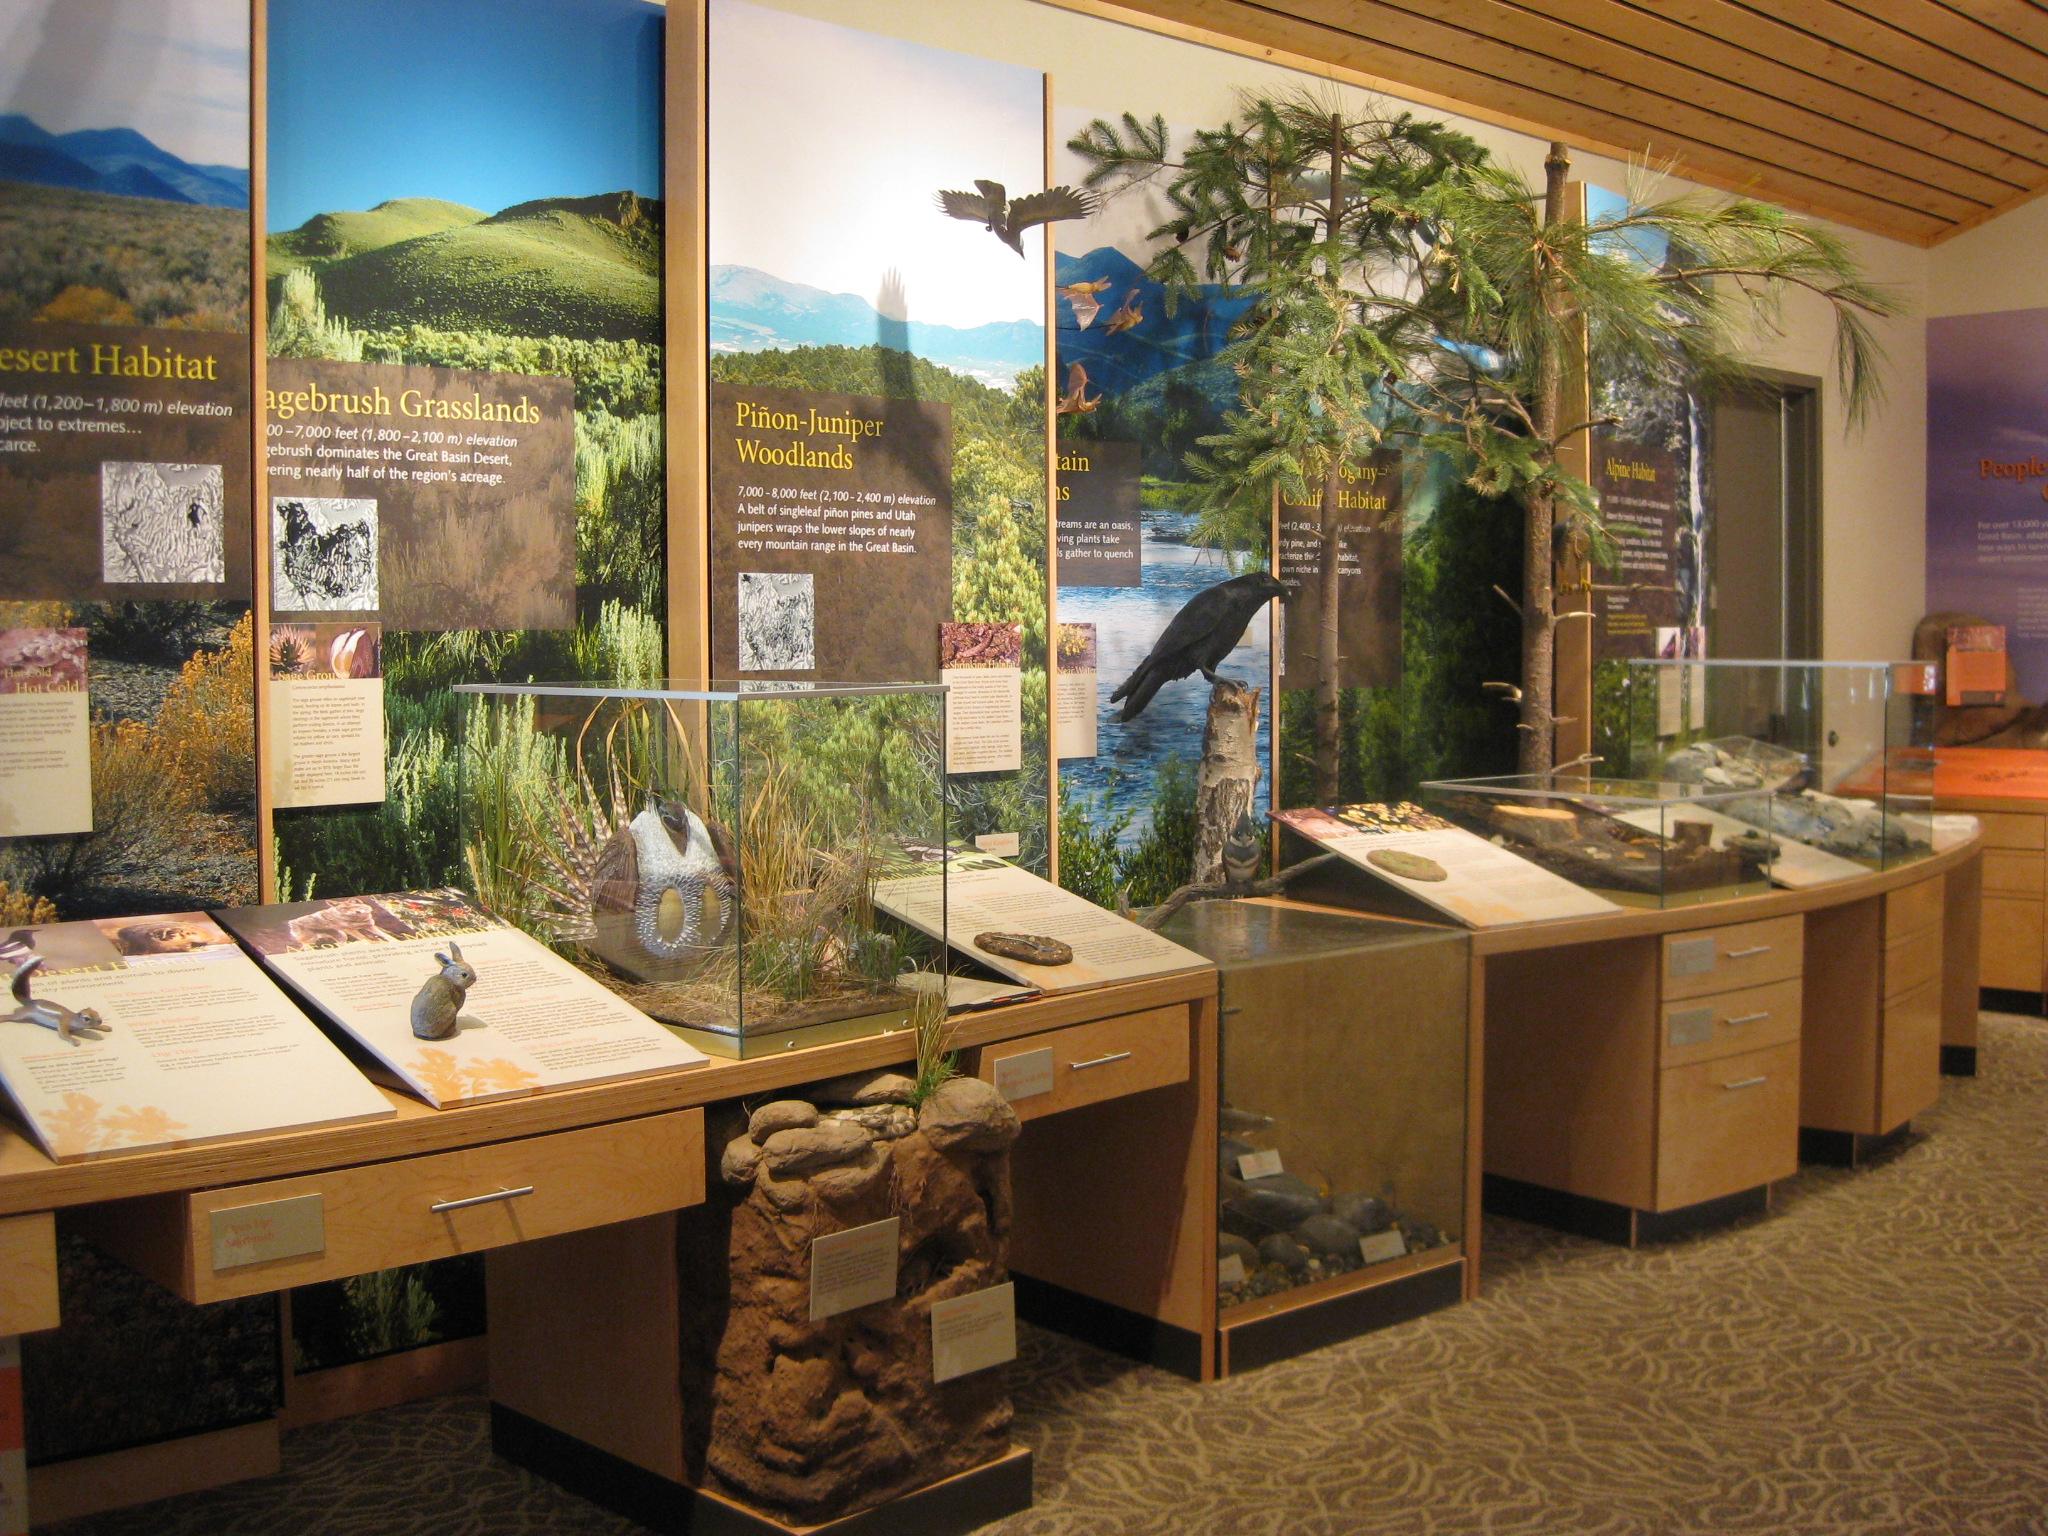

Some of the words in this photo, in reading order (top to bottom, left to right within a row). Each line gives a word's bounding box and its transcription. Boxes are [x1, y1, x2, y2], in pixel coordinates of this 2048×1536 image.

[0, 347, 80, 374] esert
[91, 343, 219, 381] Habitat
[143, 401, 163, 416] m)
[167, 400, 233, 417] elevation
[267, 383, 391, 419] agebrush
[400, 390, 541, 424] Grasslands
[37, 416, 54, 431] to
[58, 418, 142, 435] extremes...
[736, 401, 884, 443] Piñon-Juniper
[334, 426, 360, 441] feet
[447, 432, 463, 447] m)
[466, 433, 518, 448] elevation
[317, 445, 380, 460] dominates
[384, 448, 403, 461] the
[406, 448, 438, 462] Great
[441, 451, 471, 464] Basin
[474, 452, 512, 467] Desert,
[736, 438, 854, 470] Woodlands
[1056, 450, 1090, 472] tain
[305, 465, 343, 482] nearly
[347, 466, 370, 479] half
[373, 467, 387, 479] of
[390, 468, 408, 481] the
[412, 470, 457, 484] region's
[460, 473, 506, 487] acreage.
[800, 488, 817, 501] feet
[883, 493, 896, 506] m)
[898, 494, 936, 506] elevation
[1338, 490, 1388, 511] Habitat
[738, 503, 746, 514] A
[748, 502, 766, 515] belt
[768, 503, 778, 515] of
[780, 505, 822, 519] singleleaf
[824, 507, 849, 521] piñon
[851, 508, 874, 521] pines
[876, 509, 893, 521] and
[895, 510, 917, 522] Utah
[737, 520, 774, 535] junipers
[776, 524, 802, 536] wraps
[805, 522, 820, 534] the
[822, 523, 847, 535] lower
[849, 524, 876, 539] slopes
[878, 525, 888, 536] of
[890, 526, 916, 540] nearly
[1084, 521, 1097, 530] are
[1099, 521, 1110, 530] an
[1112, 521, 1134, 532] oasis,
[737, 539, 763, 552] every
[765, 539, 808, 550] mountain
[811, 542, 836, 554] range
[838, 540, 847, 551] in
[849, 541, 864, 552] the
[866, 541, 890, 553] Great
[892, 542, 917, 554] Basin.
[1076, 534, 1100, 546] plants
[1102, 534, 1120, 545] take
[1065, 548, 1091, 560] gather
[1093, 548, 1102, 558] to
[1104, 548, 1134, 561] quench
